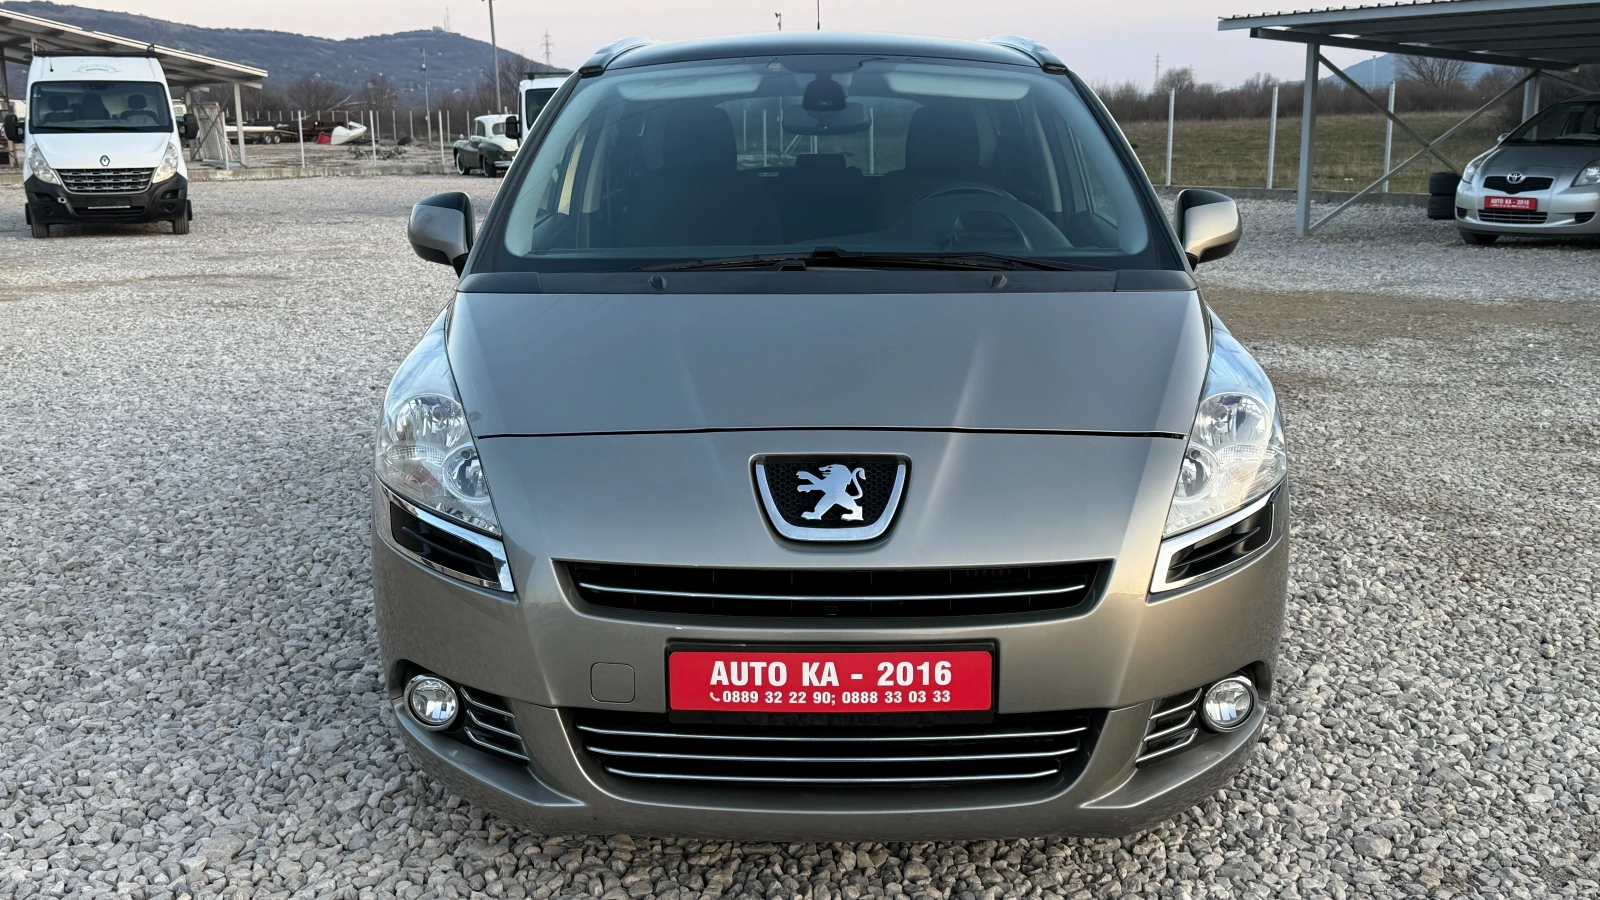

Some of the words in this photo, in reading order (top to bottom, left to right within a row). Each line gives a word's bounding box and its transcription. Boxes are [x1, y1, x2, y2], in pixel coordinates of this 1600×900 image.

[709, 660, 788, 687] AUTO
[801, 661, 840, 687] KA
[876, 660, 952, 687] 2016
[722, 690, 759, 704] 0889
[764, 690, 783, 704] 32
[788, 691, 807, 704] 22
[812, 691, 836, 706] 90;
[841, 691, 879, 704] 0888
[884, 690, 903, 704] 33
[908, 690, 927, 704] 03
[932, 689, 951, 703] 33
